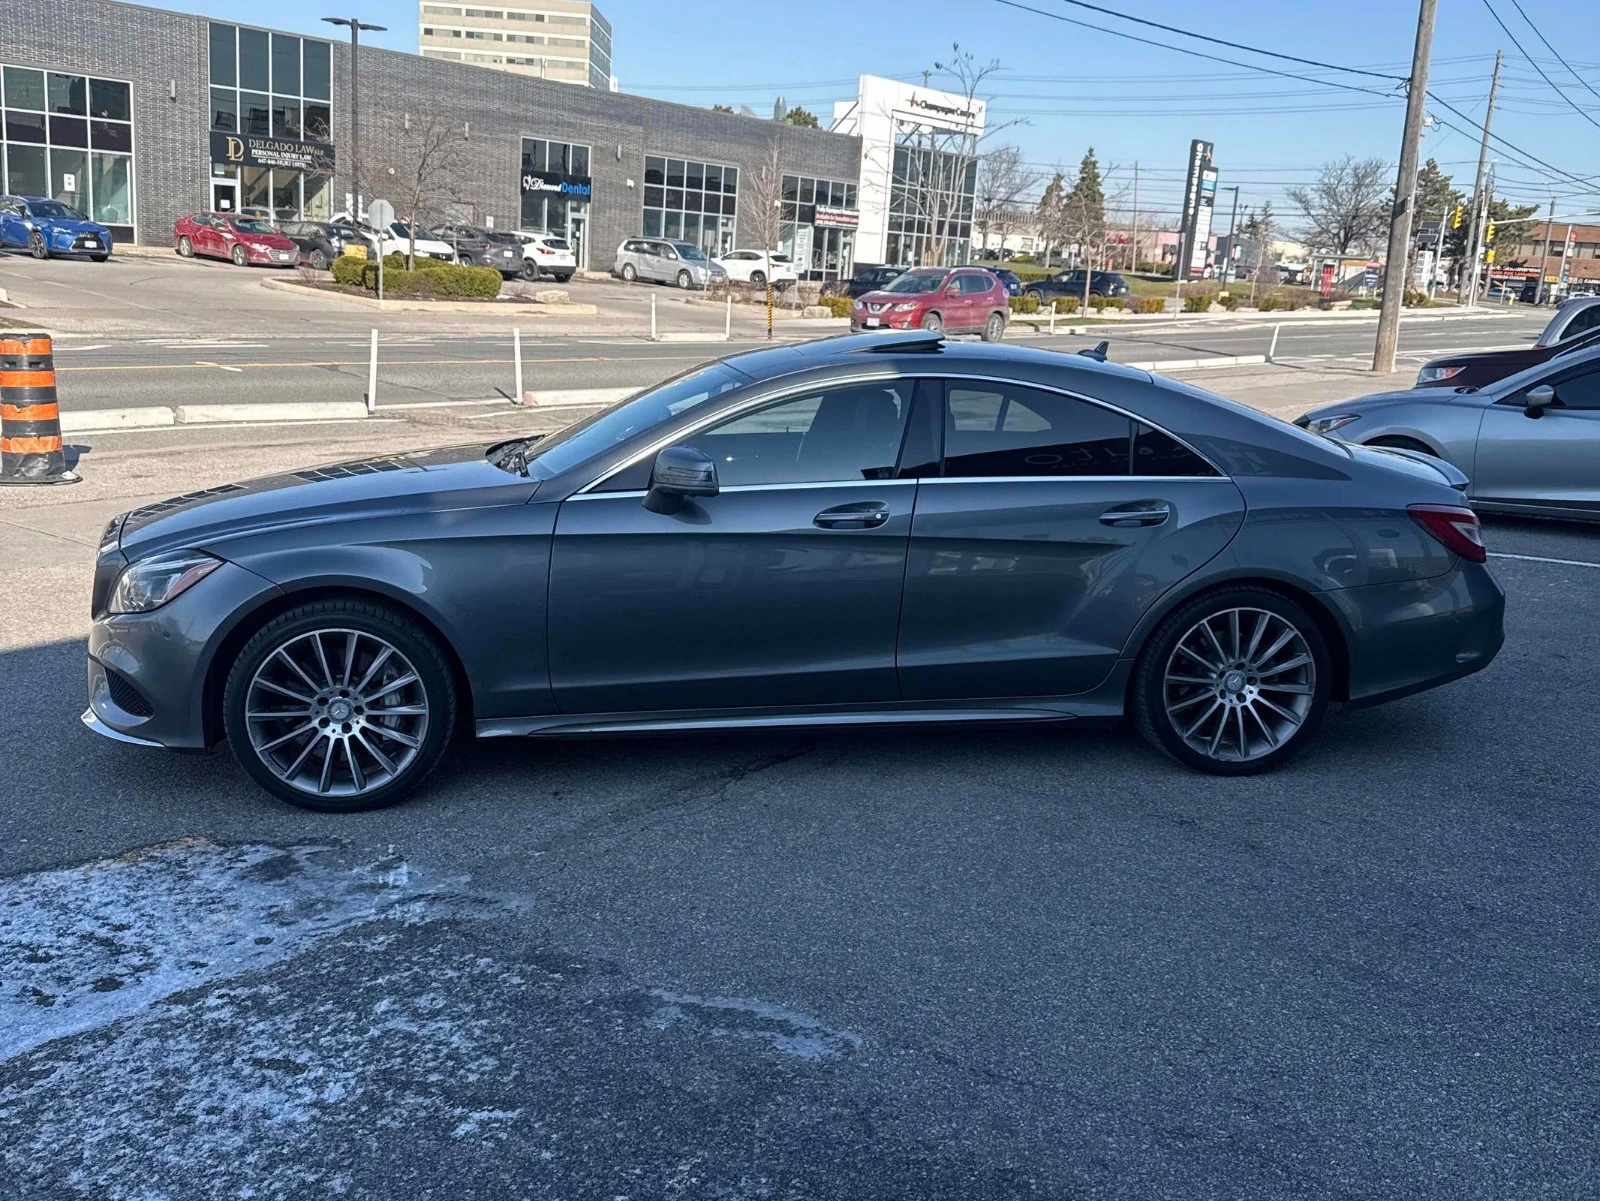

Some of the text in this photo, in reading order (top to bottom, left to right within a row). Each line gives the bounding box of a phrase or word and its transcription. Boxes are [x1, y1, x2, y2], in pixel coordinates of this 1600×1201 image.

[249, 139, 294, 152] DELGADO
[295, 144, 314, 154] LAW
[251, 148, 280, 158] PERSONAL
[280, 151, 300, 160] INJURY
[530, 177, 590, 195] Diamond Dental
